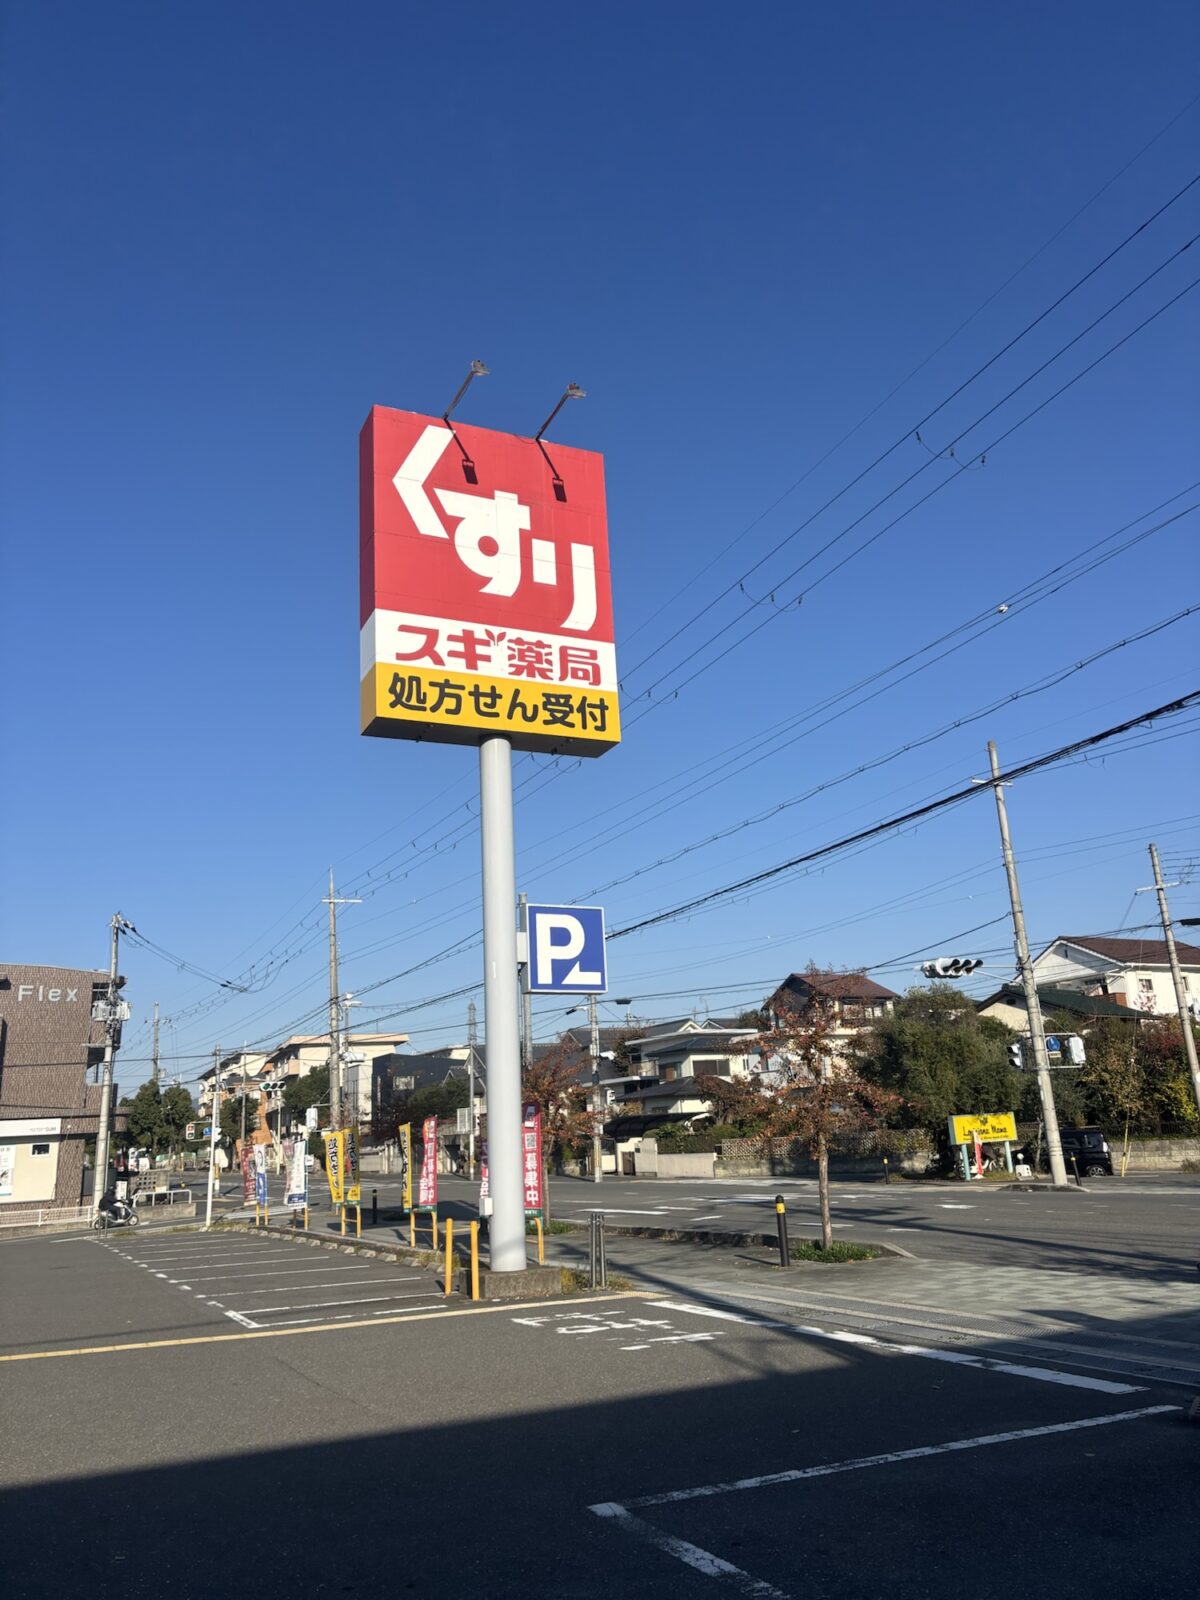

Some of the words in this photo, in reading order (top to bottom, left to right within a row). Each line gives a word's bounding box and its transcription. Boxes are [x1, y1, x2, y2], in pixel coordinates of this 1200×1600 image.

[392, 424, 597, 632] くすり
[395, 624, 601, 686] スギ薬局
[389, 671, 608, 732] 処方せん受付
[535, 912, 585, 985] P
[17, 985, 79, 1002] Flex
